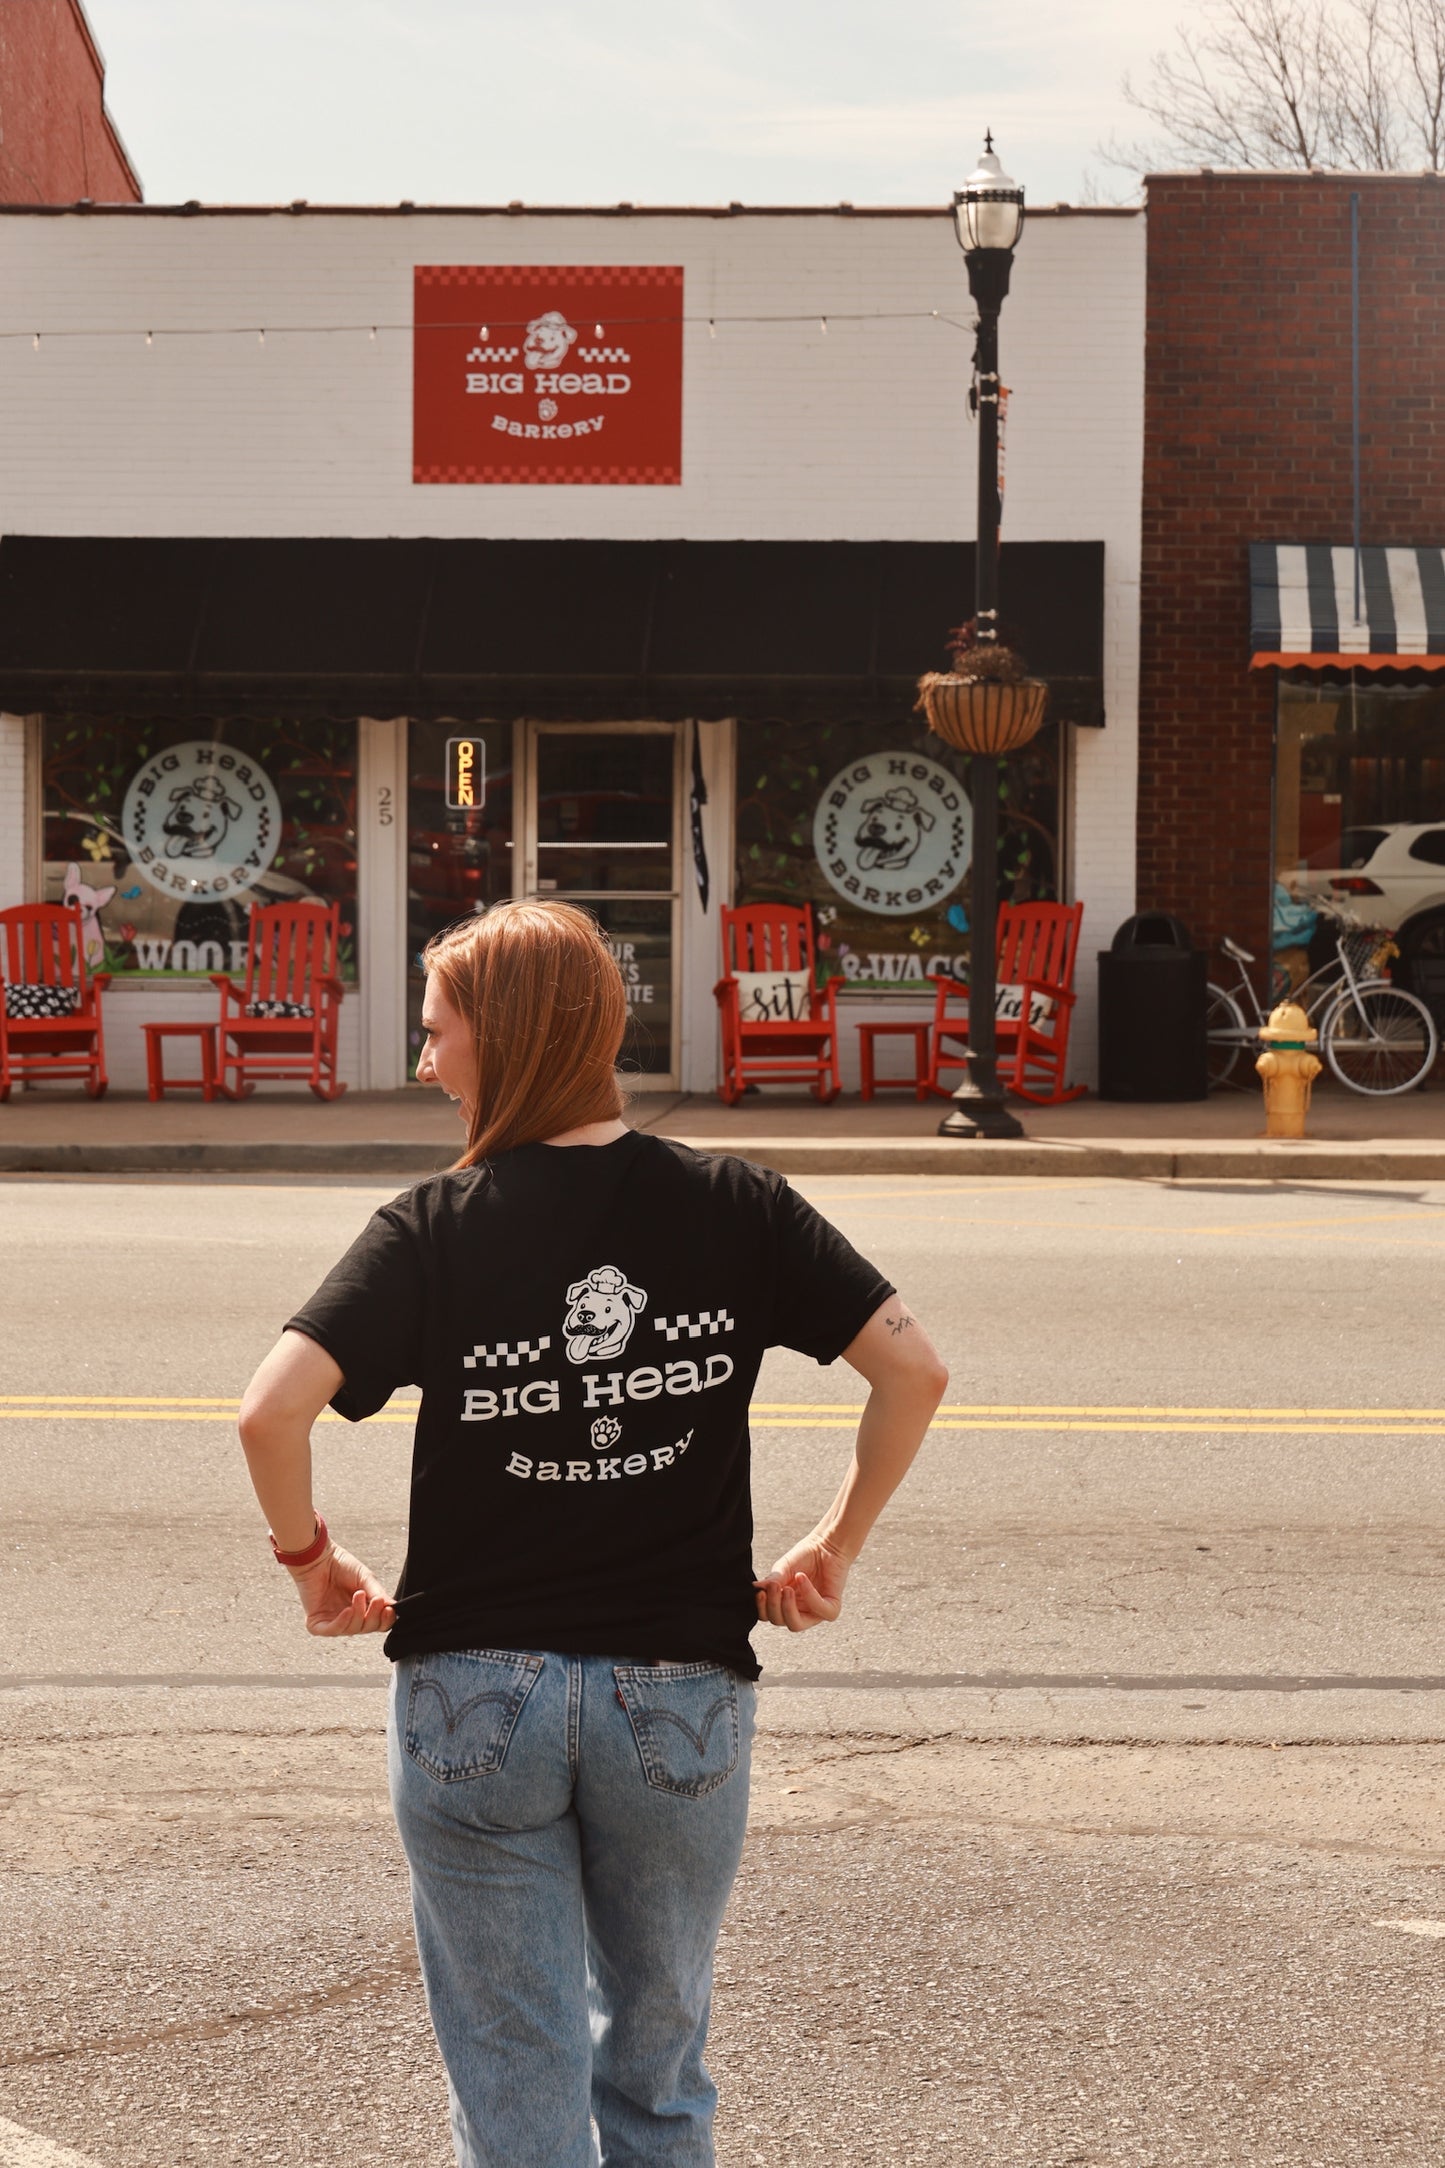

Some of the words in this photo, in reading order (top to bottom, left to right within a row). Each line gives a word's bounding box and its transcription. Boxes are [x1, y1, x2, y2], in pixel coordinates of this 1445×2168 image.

[465, 373, 524, 394] BIG
[137, 754, 181, 797] BIG
[458, 741, 474, 806] OPEN
[828, 766, 872, 809] BIG
[378, 787, 393, 826] 25
[741, 978, 811, 1021] sit
[995, 988, 1052, 1024] tay
[460, 1380, 560, 1421] BIG
